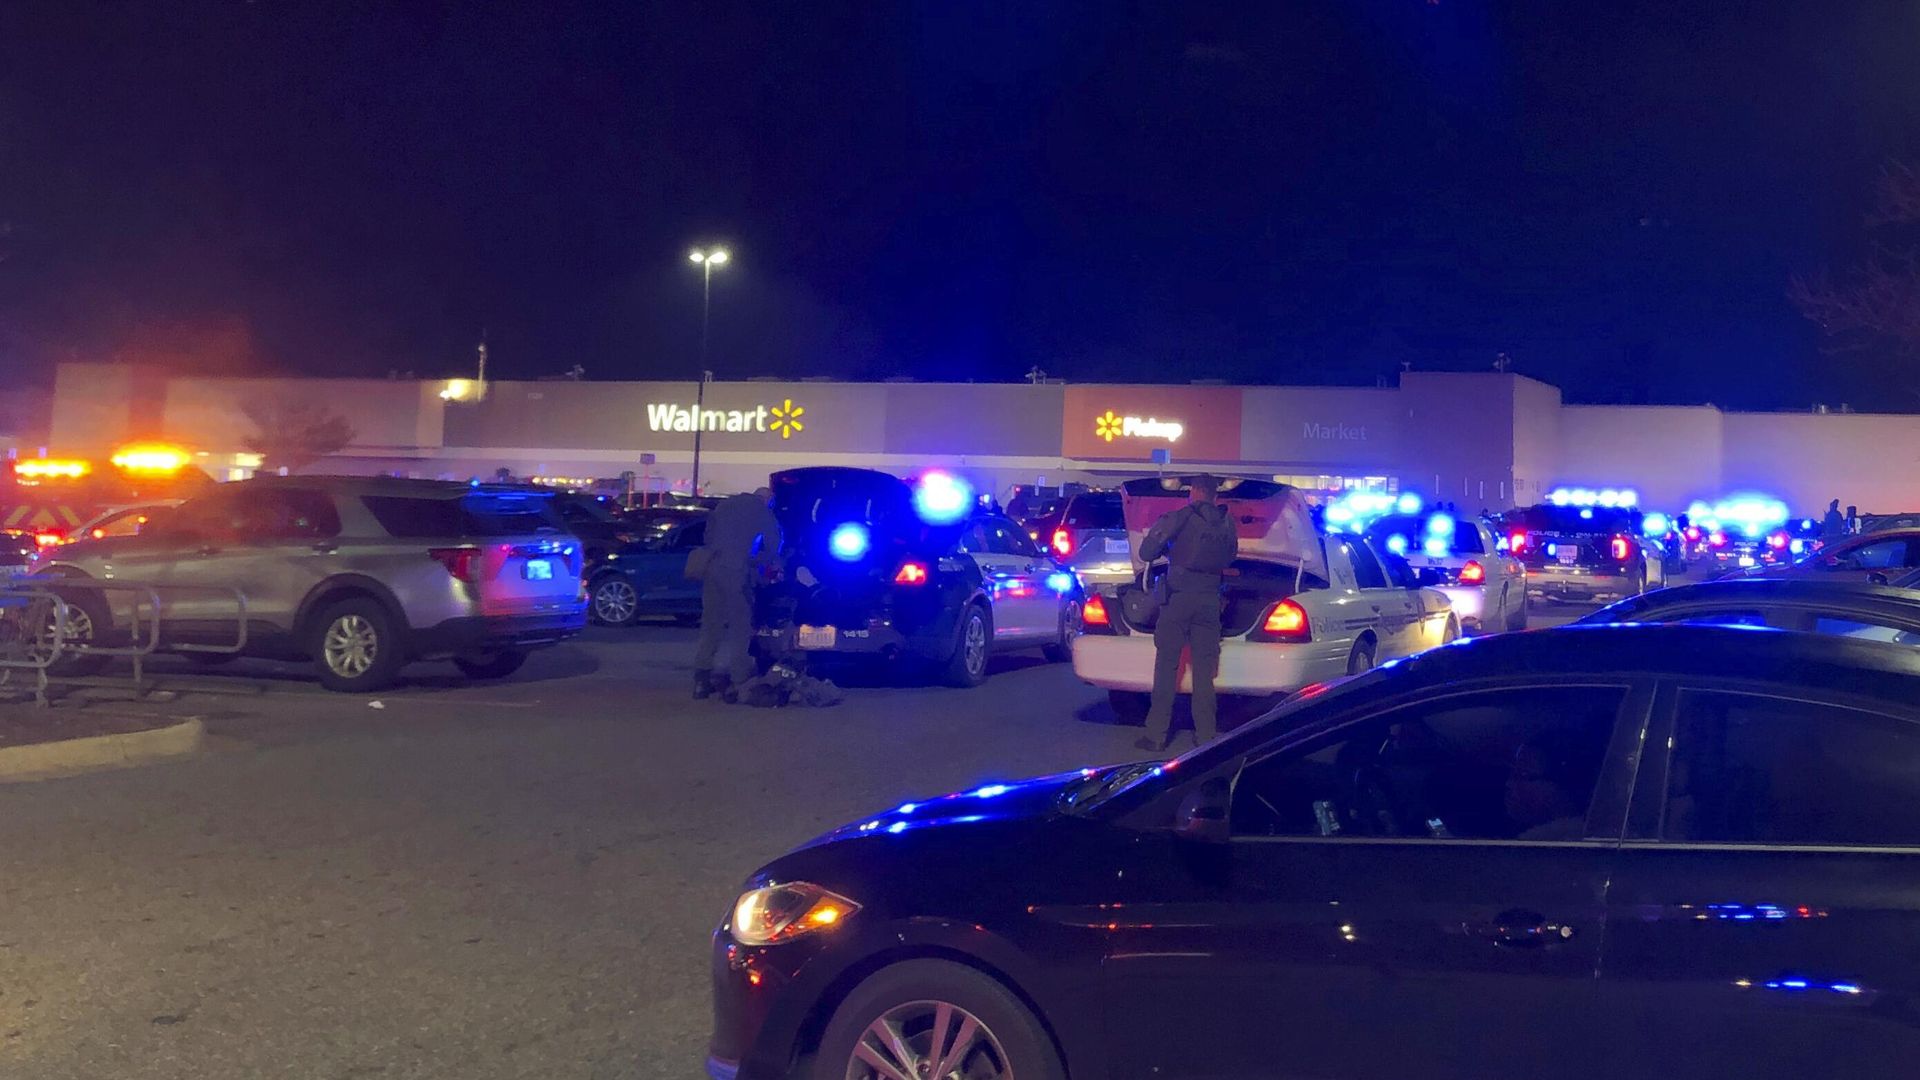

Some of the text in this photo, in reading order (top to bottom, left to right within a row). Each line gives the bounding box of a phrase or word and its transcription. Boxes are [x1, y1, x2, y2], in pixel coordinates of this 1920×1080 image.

[647, 404, 768, 433] Walmart
[1123, 417, 1183, 442] Pickup
[1302, 422, 1367, 441] Market
[1526, 530, 1560, 538] POLICE
